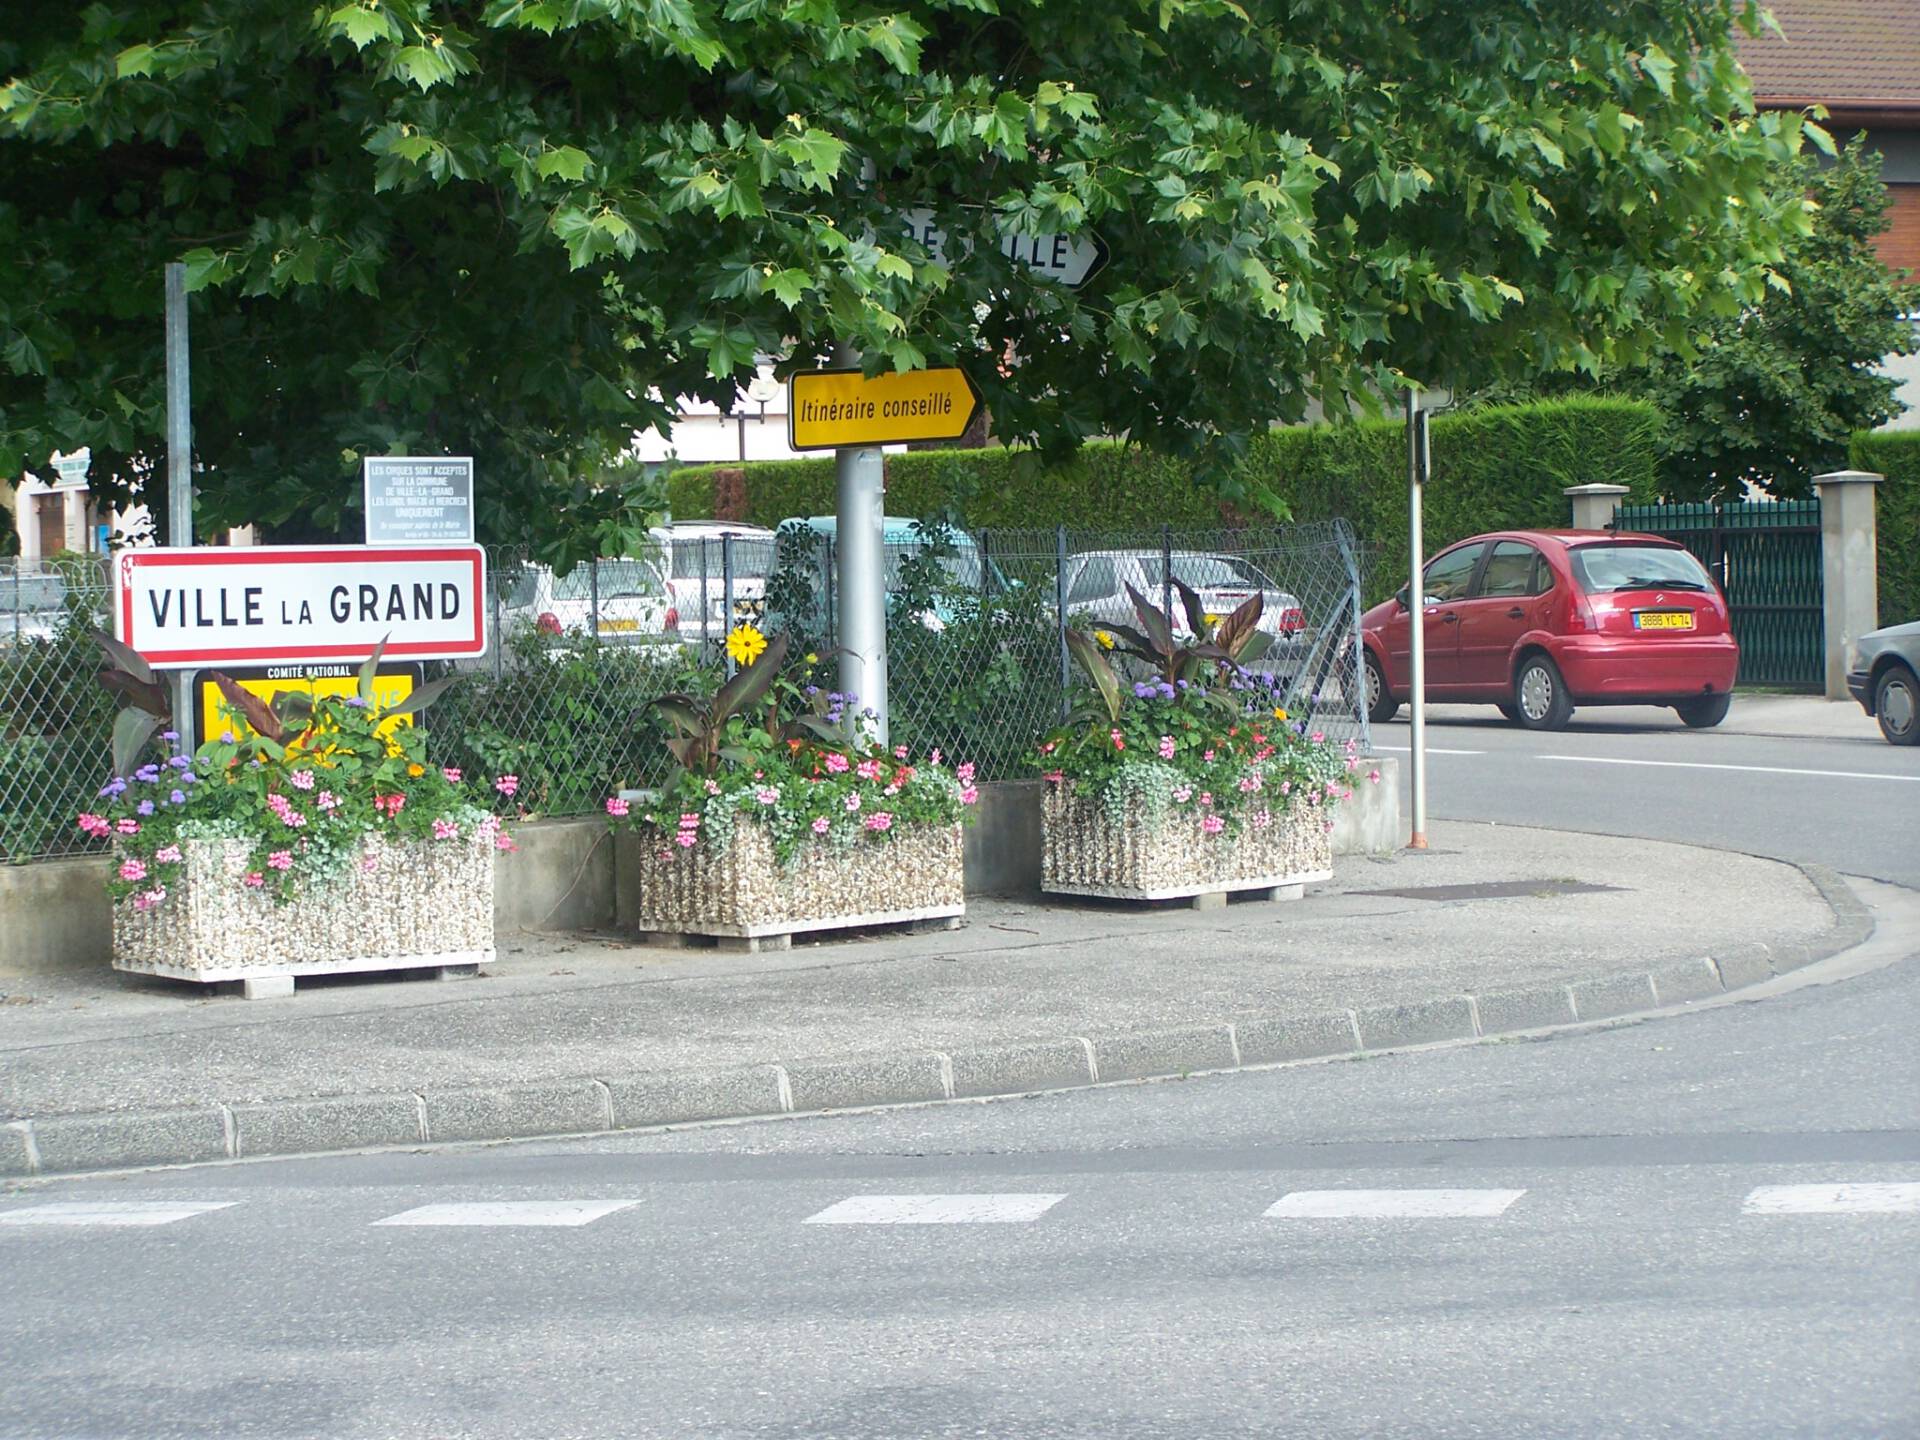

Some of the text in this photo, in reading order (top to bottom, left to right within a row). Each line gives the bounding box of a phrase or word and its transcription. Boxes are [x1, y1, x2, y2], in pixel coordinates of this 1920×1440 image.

[801, 391, 952, 423] Itinéraire conseillé
[149, 583, 461, 628] VILLE LA GRAND
[267, 664, 351, 679] COMITÉ NATIONAL
